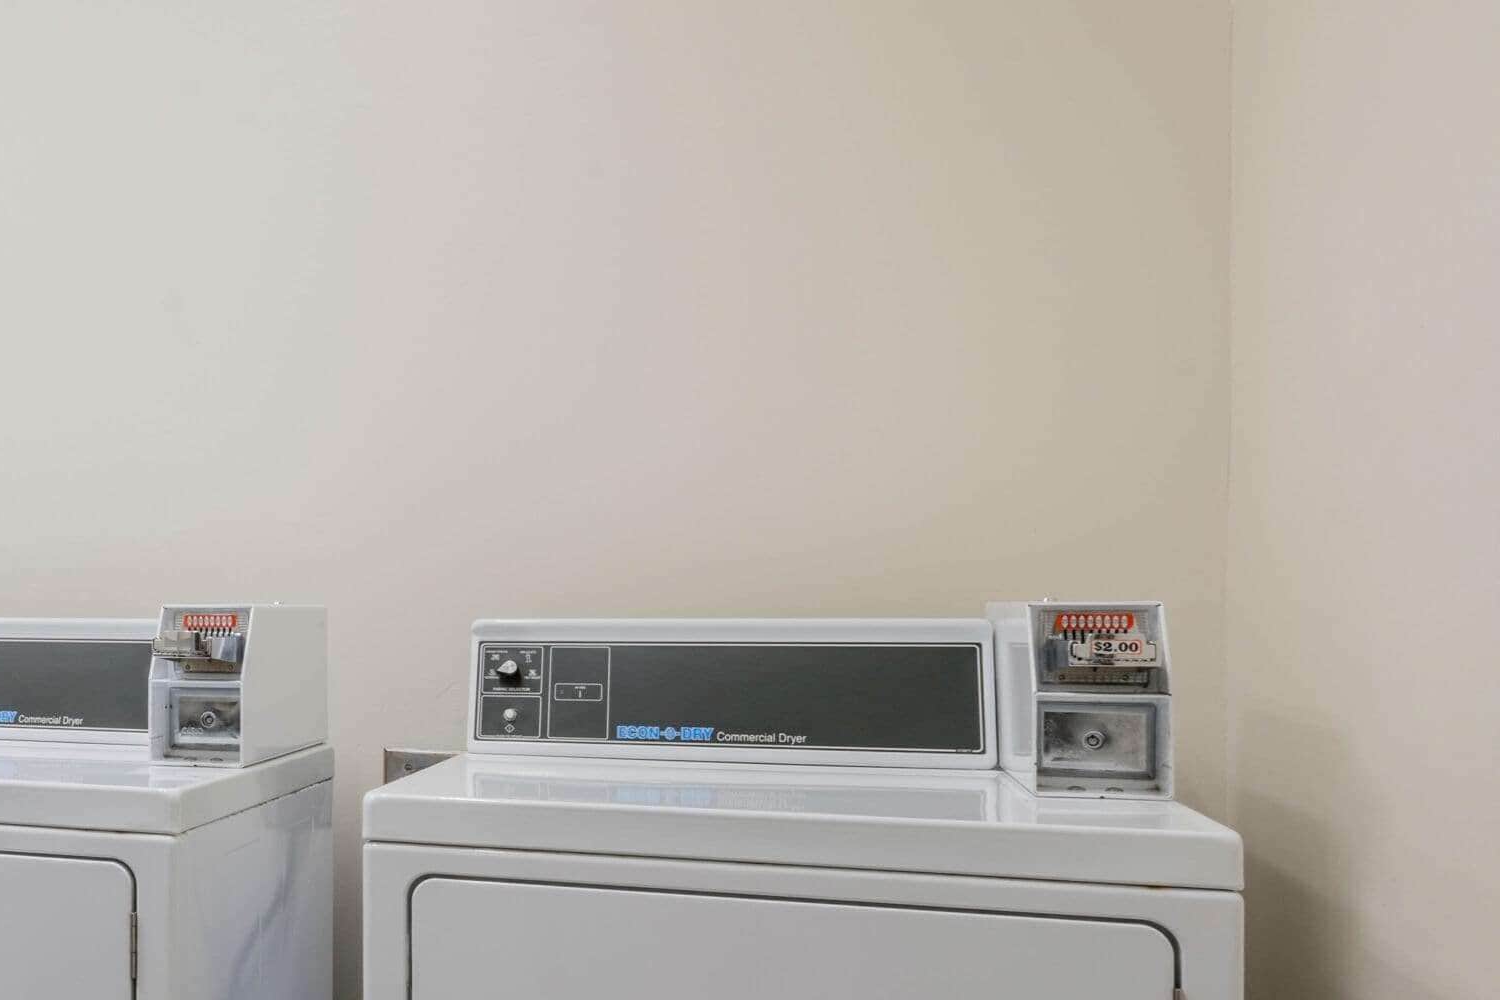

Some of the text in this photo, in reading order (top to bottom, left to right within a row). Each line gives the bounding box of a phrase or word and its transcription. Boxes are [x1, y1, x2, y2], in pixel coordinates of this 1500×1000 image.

[1094, 641, 1139, 653] $2.00
[18, 714, 61, 725] Commercial
[62, 715, 84, 727] Dryer
[616, 726, 807, 745] ECON-O-DRY Commercial Dryer
